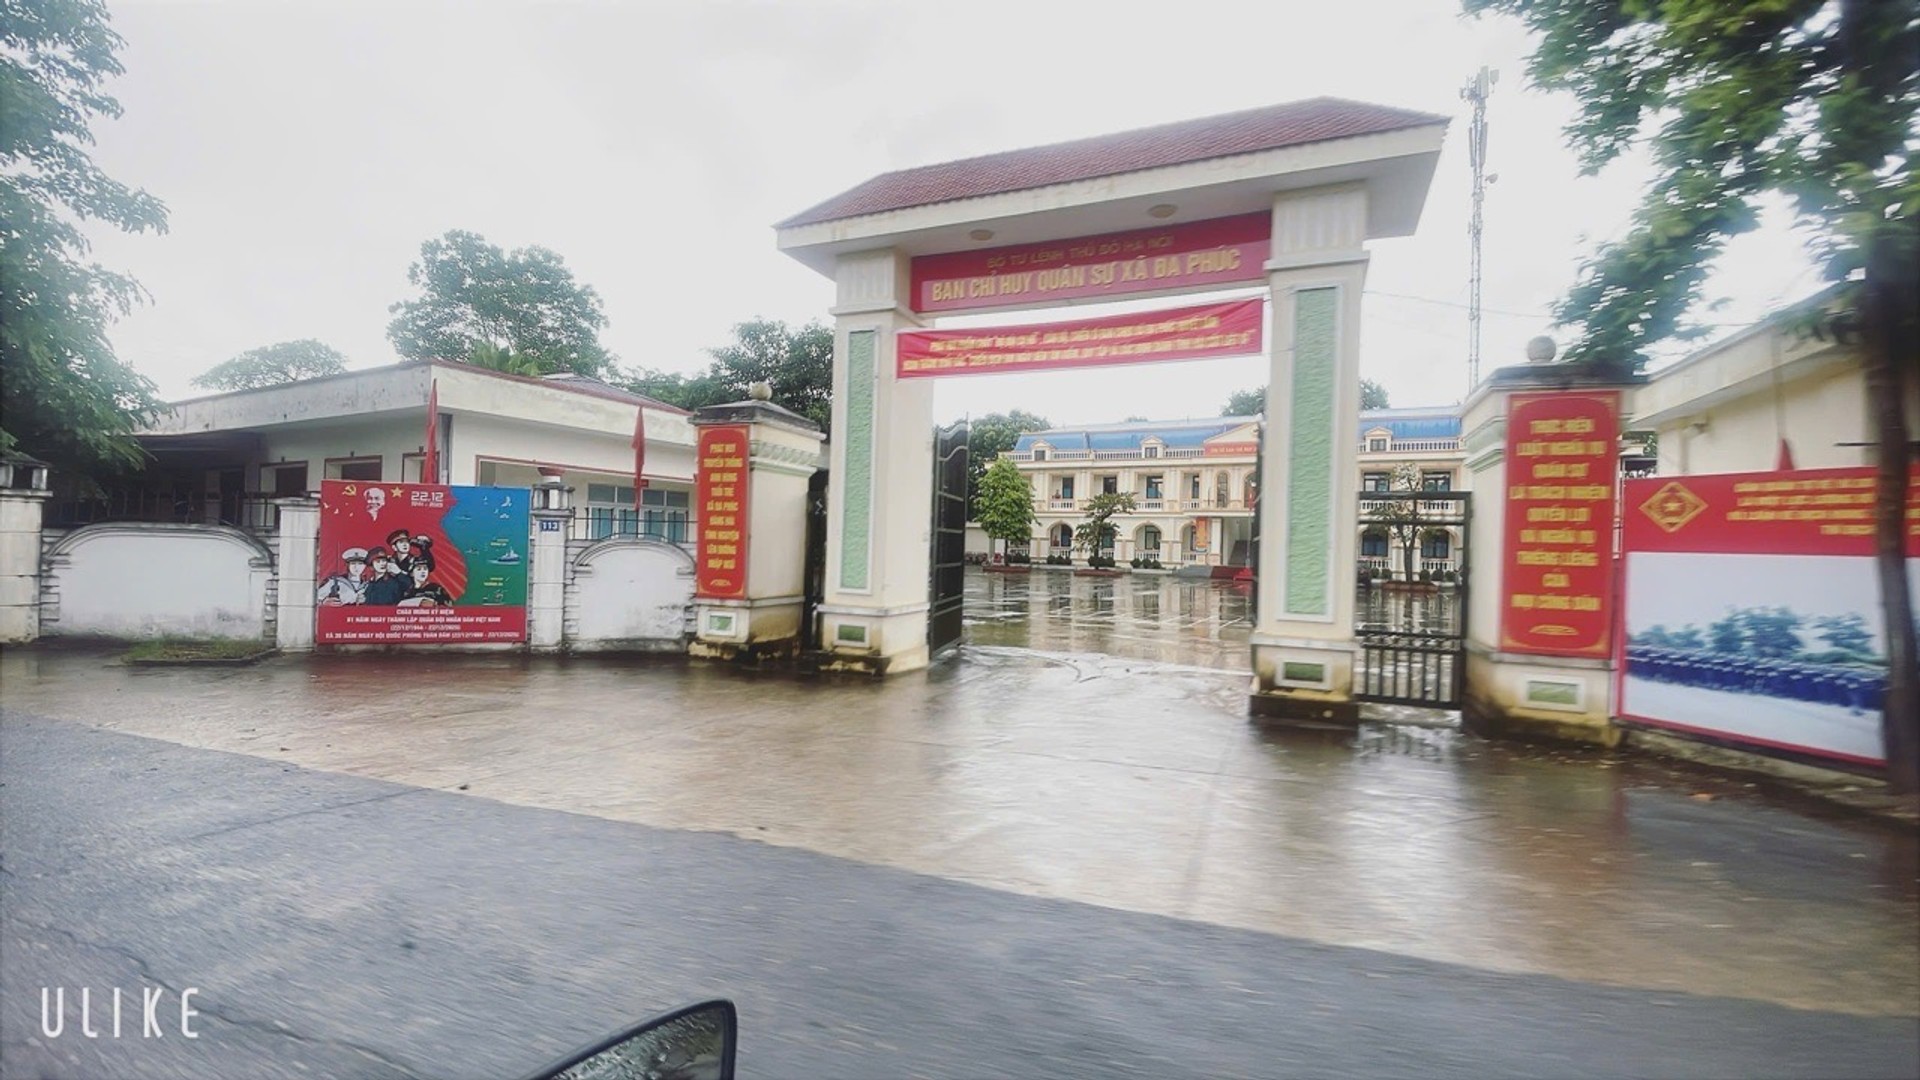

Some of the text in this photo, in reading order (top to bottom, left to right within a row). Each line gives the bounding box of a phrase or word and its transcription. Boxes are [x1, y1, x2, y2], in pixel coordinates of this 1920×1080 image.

[932, 245, 1241, 302] BAN CHỈ HUY QUÂN SỰ XÃ ĐA PHÚC
[411, 490, 444, 502] 22.12
